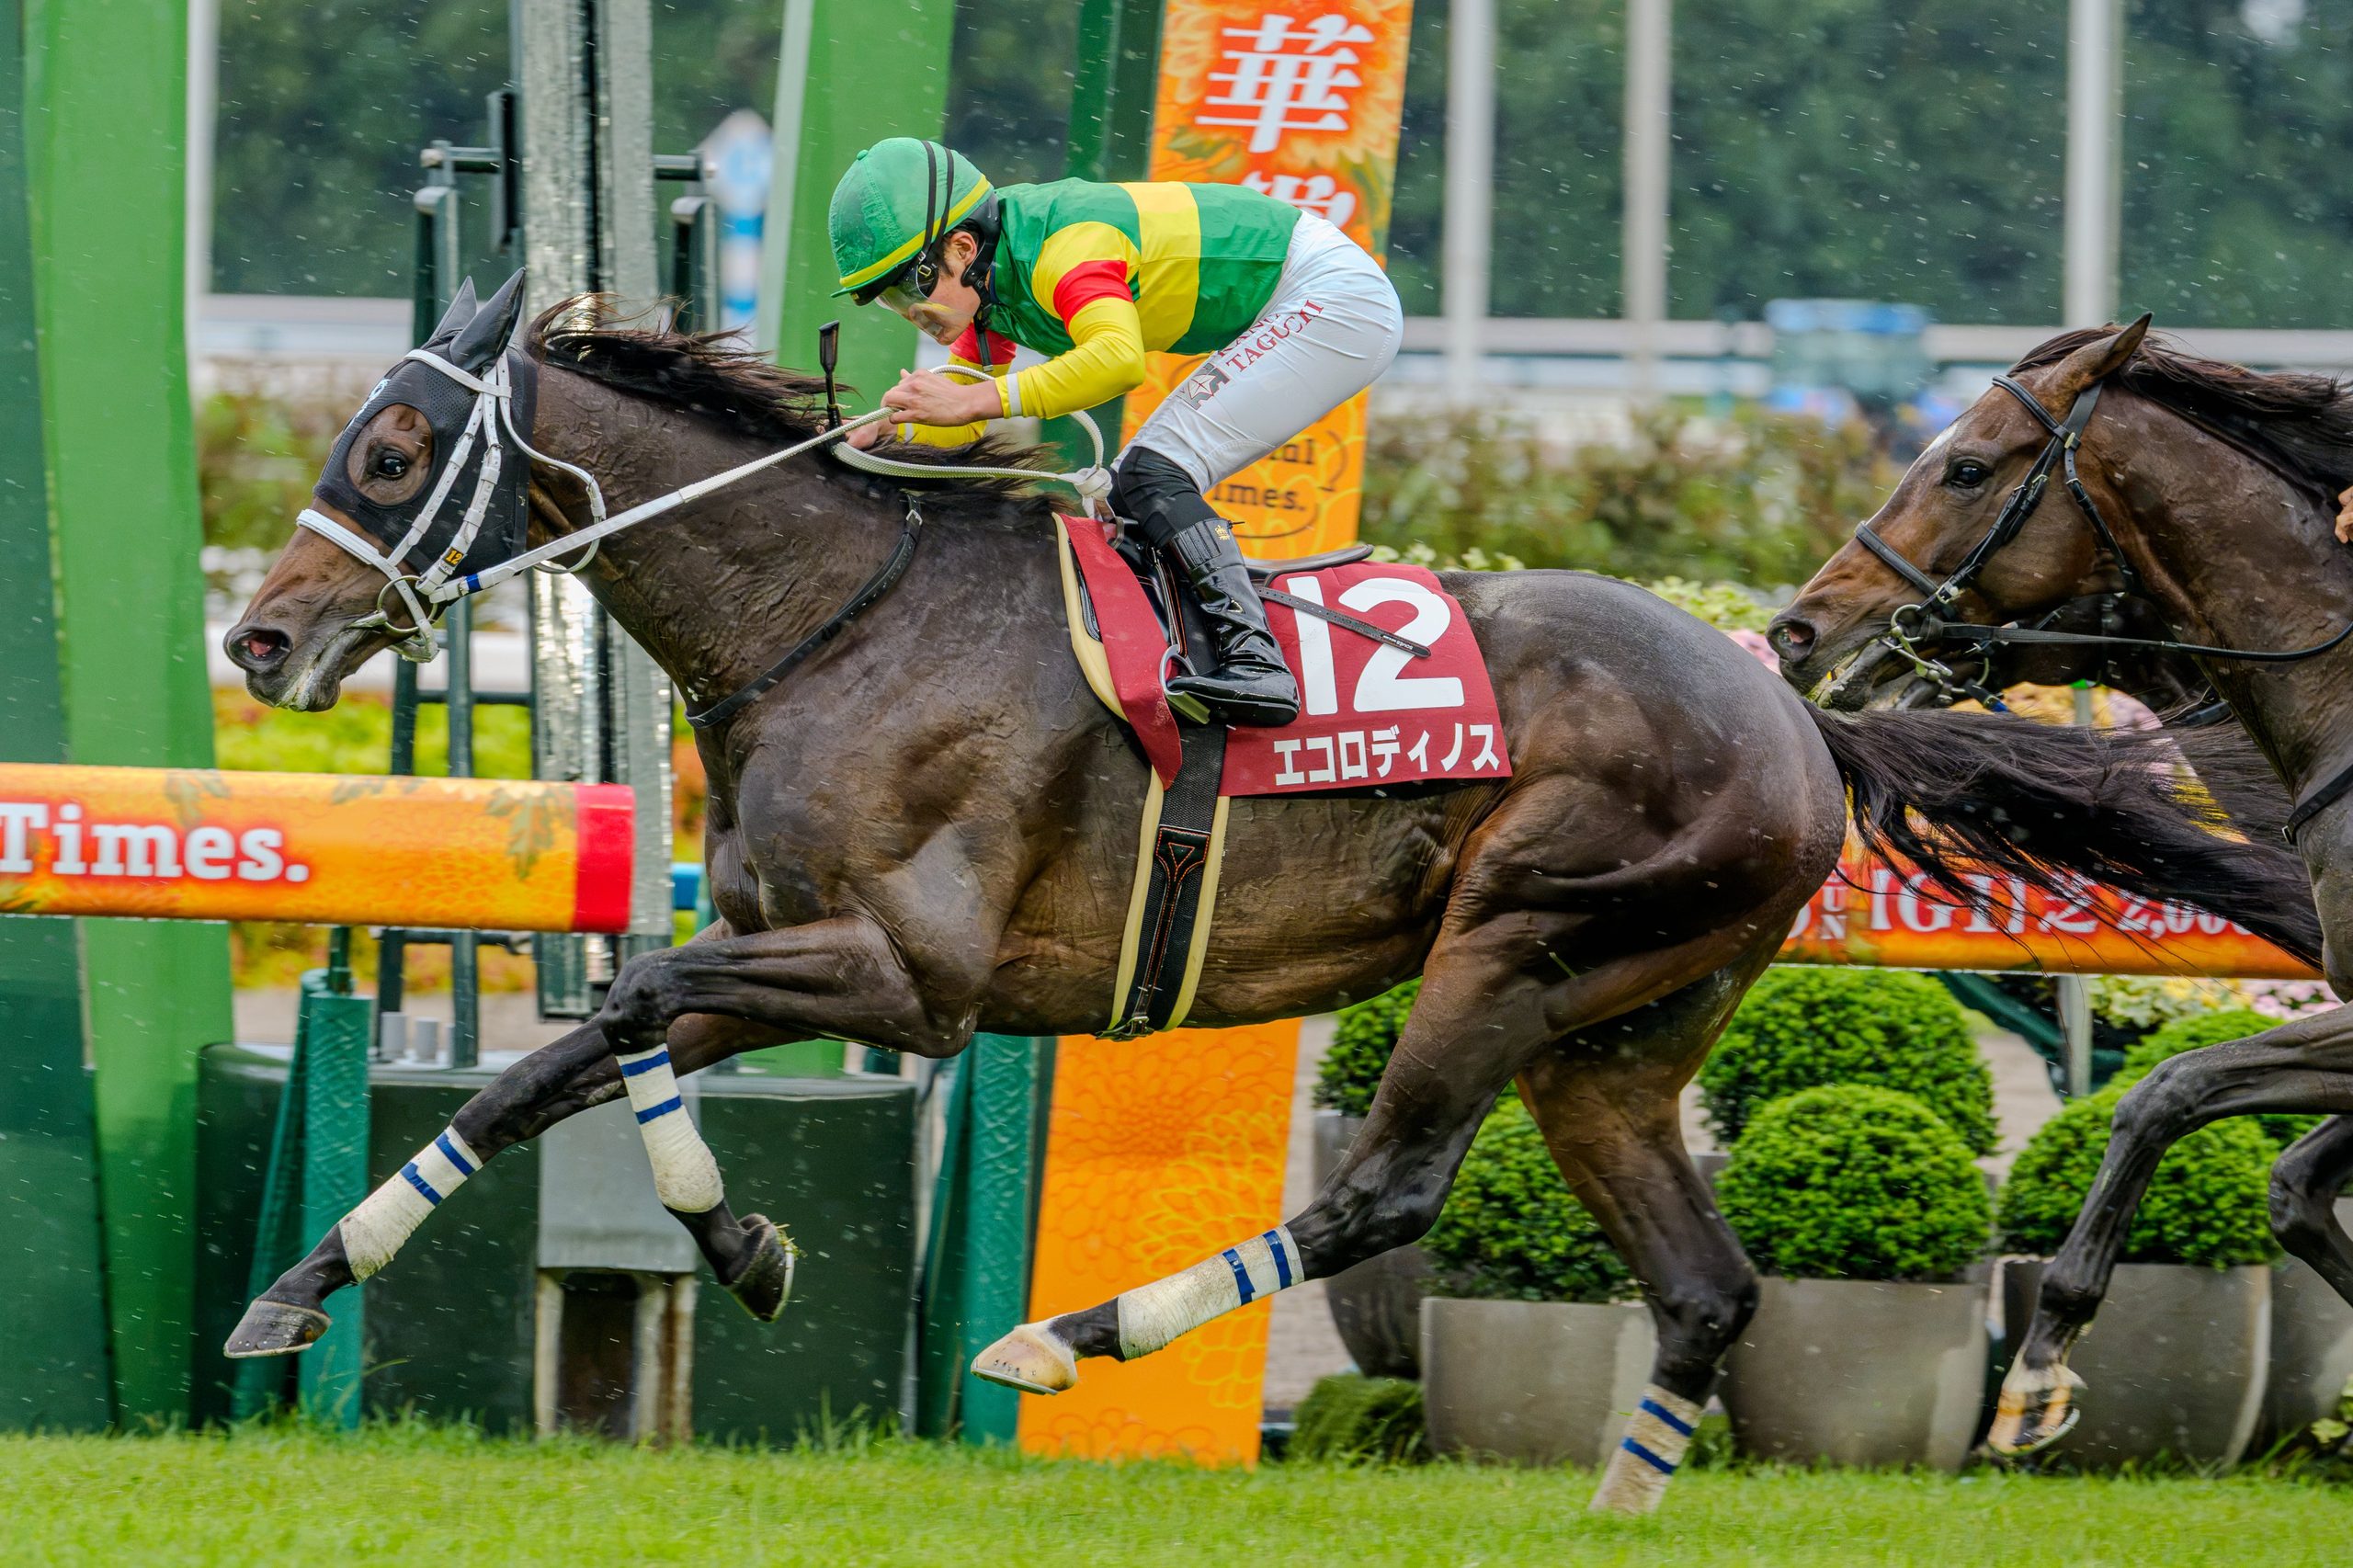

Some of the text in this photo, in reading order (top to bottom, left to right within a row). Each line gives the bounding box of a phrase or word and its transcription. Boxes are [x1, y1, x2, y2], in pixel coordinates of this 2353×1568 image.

[446, 550, 463, 565] 12
[1287, 576, 1465, 716] 12
[1274, 722, 1500, 786] エコロディノス
[0, 802, 309, 882] Times.
